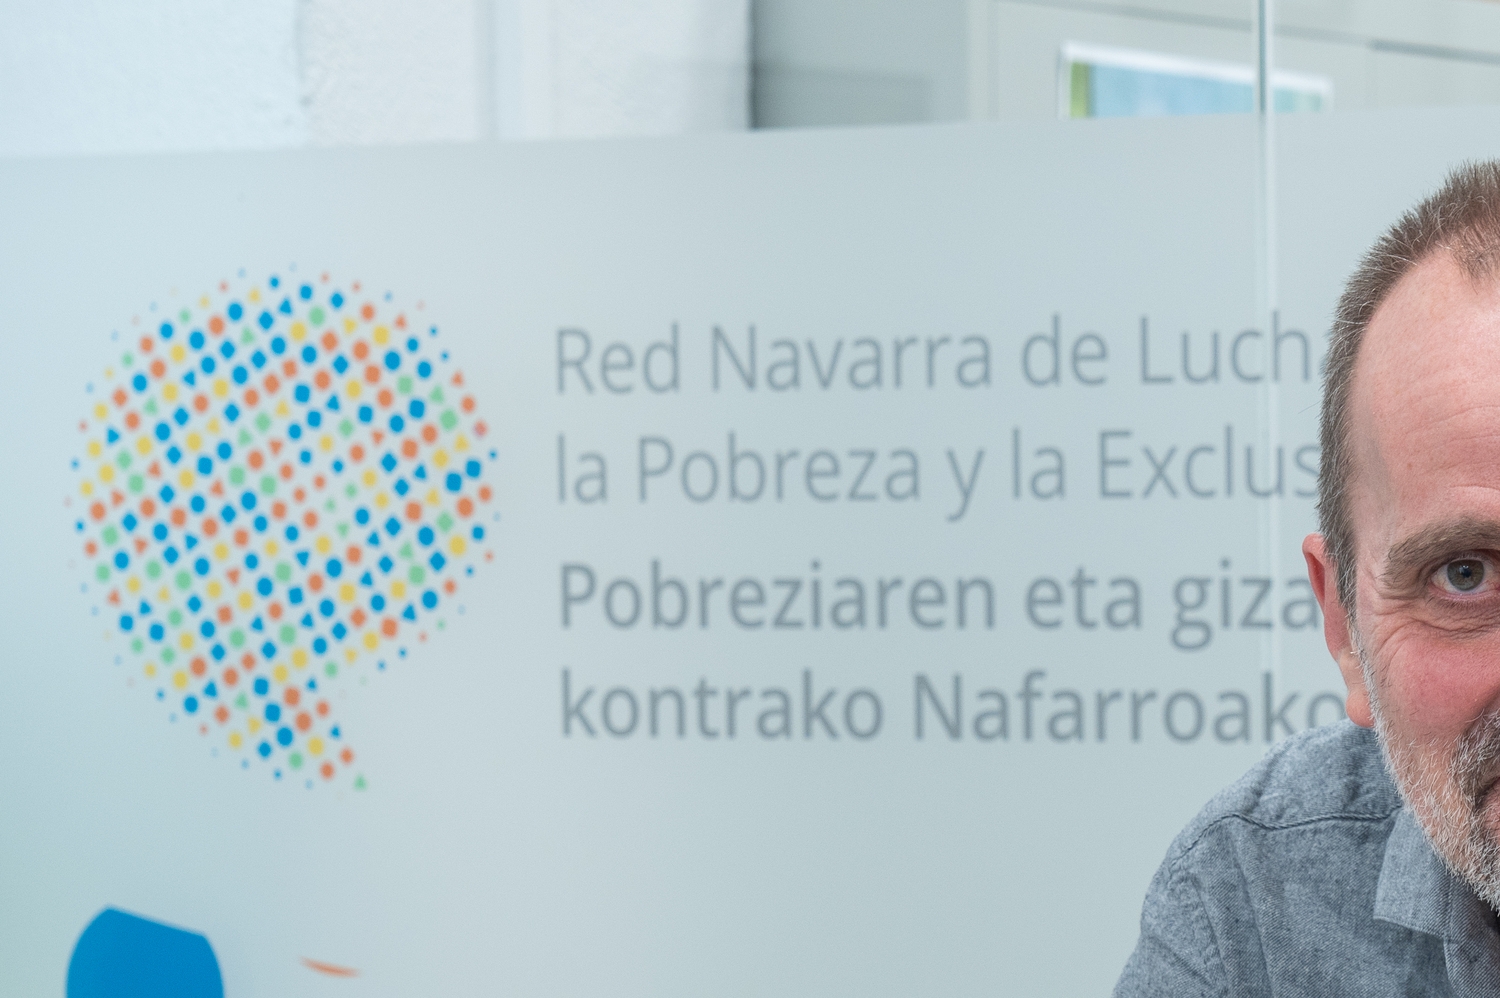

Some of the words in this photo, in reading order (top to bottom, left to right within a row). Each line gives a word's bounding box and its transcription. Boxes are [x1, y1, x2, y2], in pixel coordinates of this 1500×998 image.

[555, 321, 682, 396] Red
[710, 324, 992, 393] Navarra
[1020, 312, 1111, 389] de
[1138, 310, 1330, 387] Luch
[556, 433, 609, 505] la
[637, 430, 921, 504] Pobreza
[945, 448, 986, 524] y
[1011, 426, 1067, 502] la
[1097, 424, 1320, 500] Exclus
[559, 557, 997, 632] Pobreziaren
[1022, 566, 1144, 632] eta
[560, 666, 885, 743] kontrako
[912, 667, 1346, 746] Nafarroako
